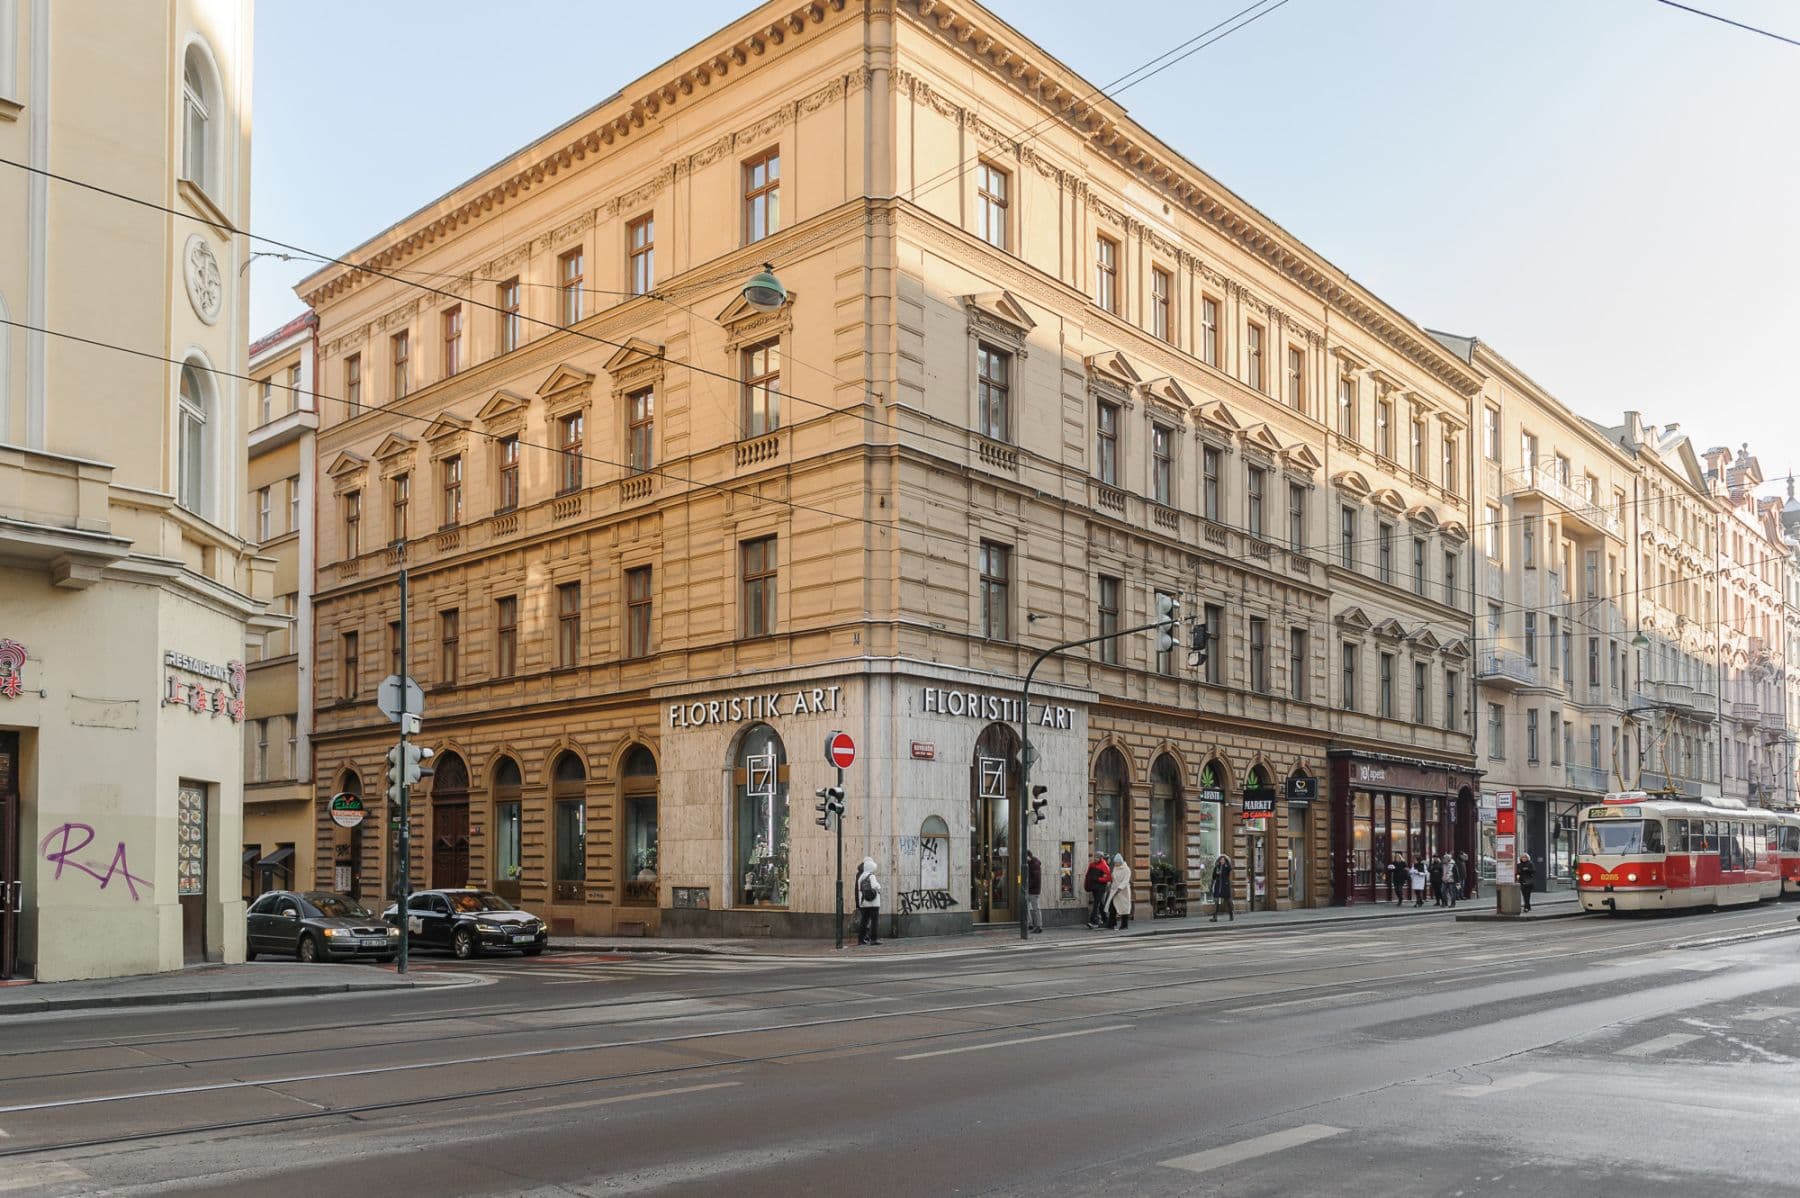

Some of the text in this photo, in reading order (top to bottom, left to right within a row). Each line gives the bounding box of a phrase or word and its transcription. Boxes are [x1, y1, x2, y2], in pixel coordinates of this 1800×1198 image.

[166, 651, 231, 683] RESTAURANT
[669, 686, 840, 728] FLORISTIK ART
[1041, 703, 1075, 730] ART
[1243, 800, 1273, 811] MARKET
